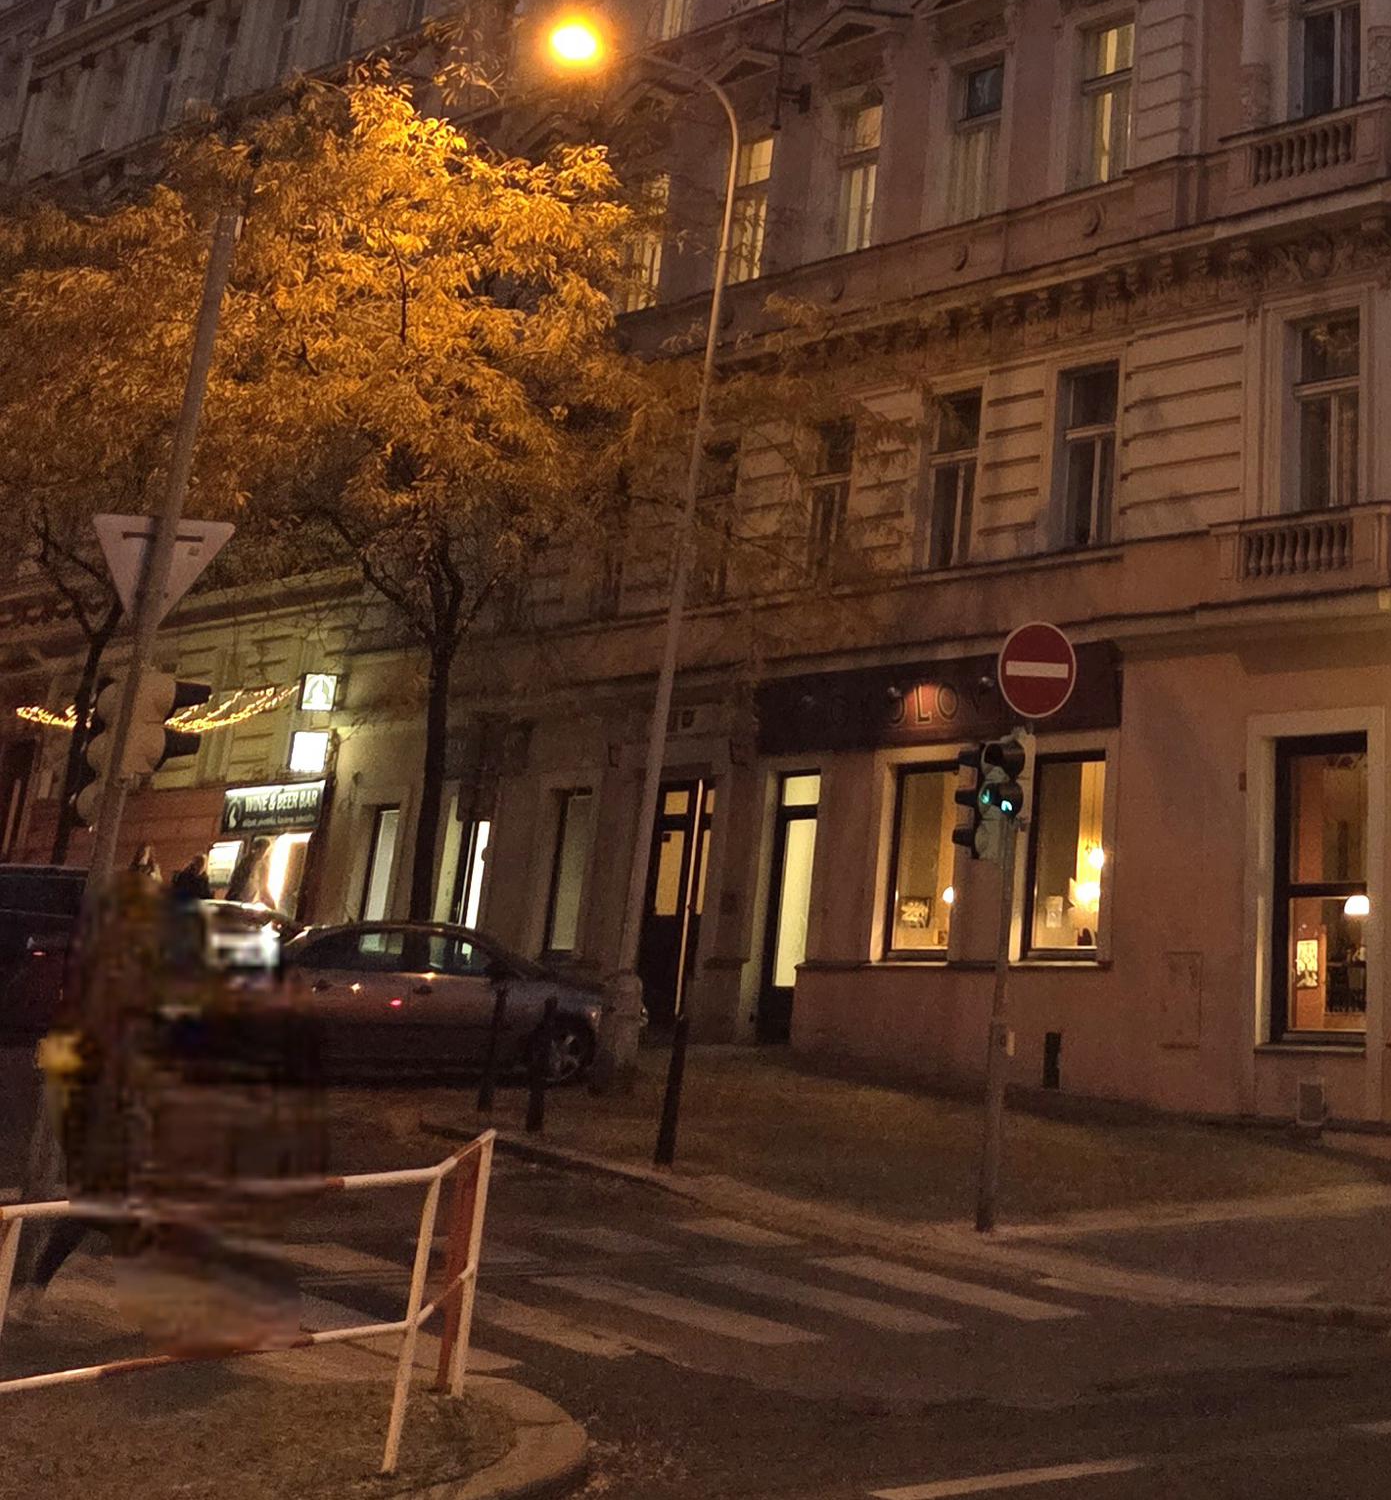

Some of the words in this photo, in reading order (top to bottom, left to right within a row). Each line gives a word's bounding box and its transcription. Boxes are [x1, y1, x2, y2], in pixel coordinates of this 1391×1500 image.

[245, 795, 268, 812] WINE
[268, 793, 277, 811] &
[276, 791, 298, 810] BEER
[298, 790, 318, 808] BAR
